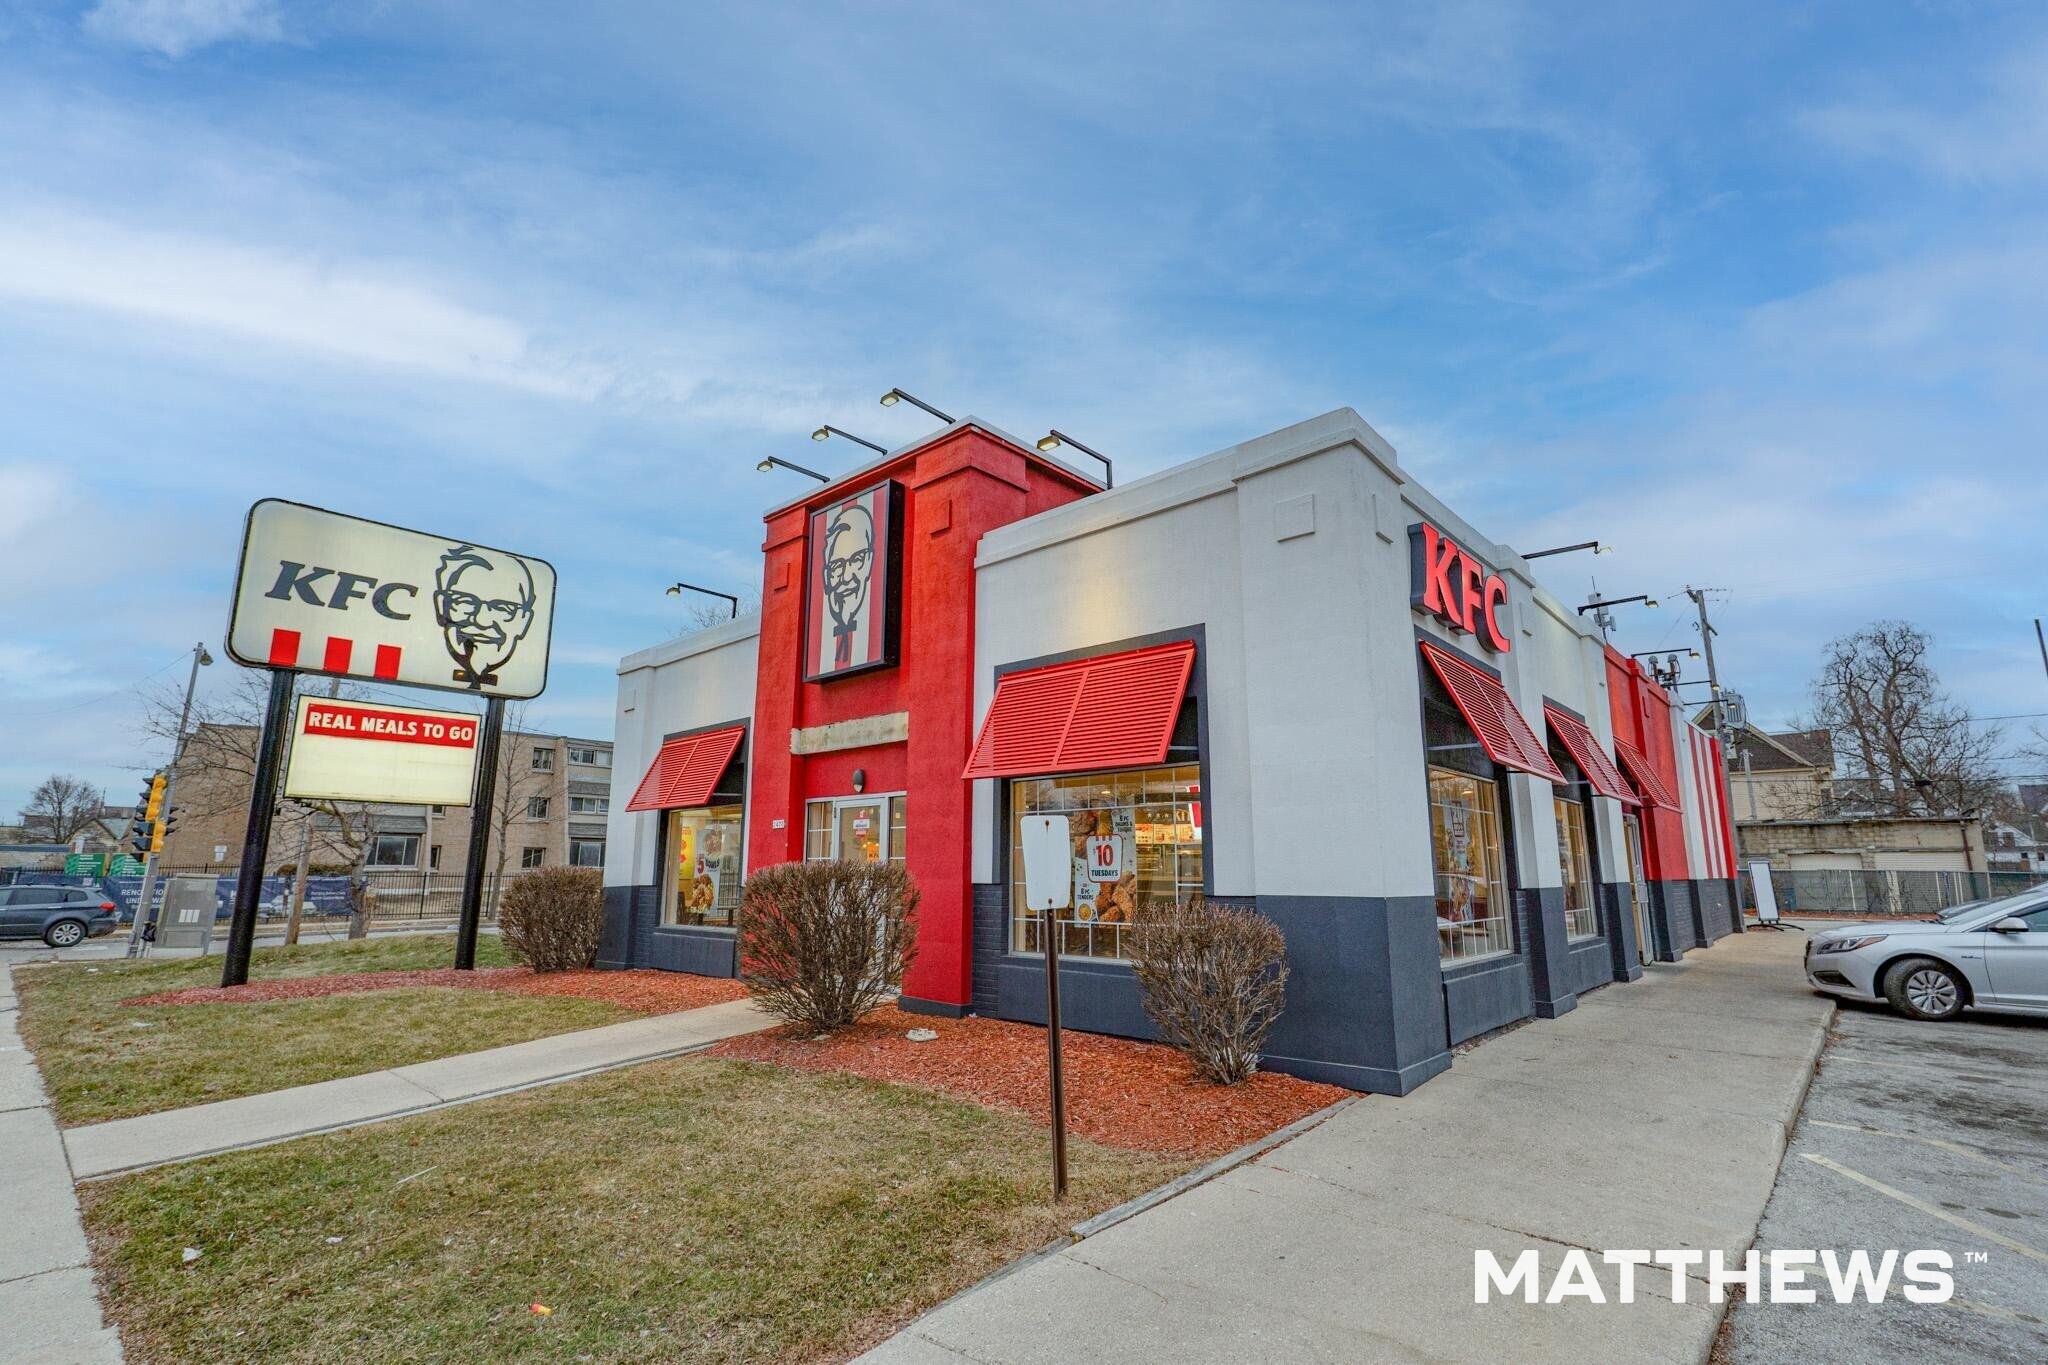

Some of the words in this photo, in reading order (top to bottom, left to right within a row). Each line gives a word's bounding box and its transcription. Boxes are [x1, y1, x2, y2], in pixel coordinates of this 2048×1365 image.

[264, 560, 419, 621] KFC
[1420, 521, 1511, 653] KFC
[308, 711, 356, 731] REAL
[361, 716, 417, 736] MEALS
[422, 722, 445, 739] TO
[449, 726, 473, 741] GO
[1091, 869, 1119, 877] TUESDAYS
